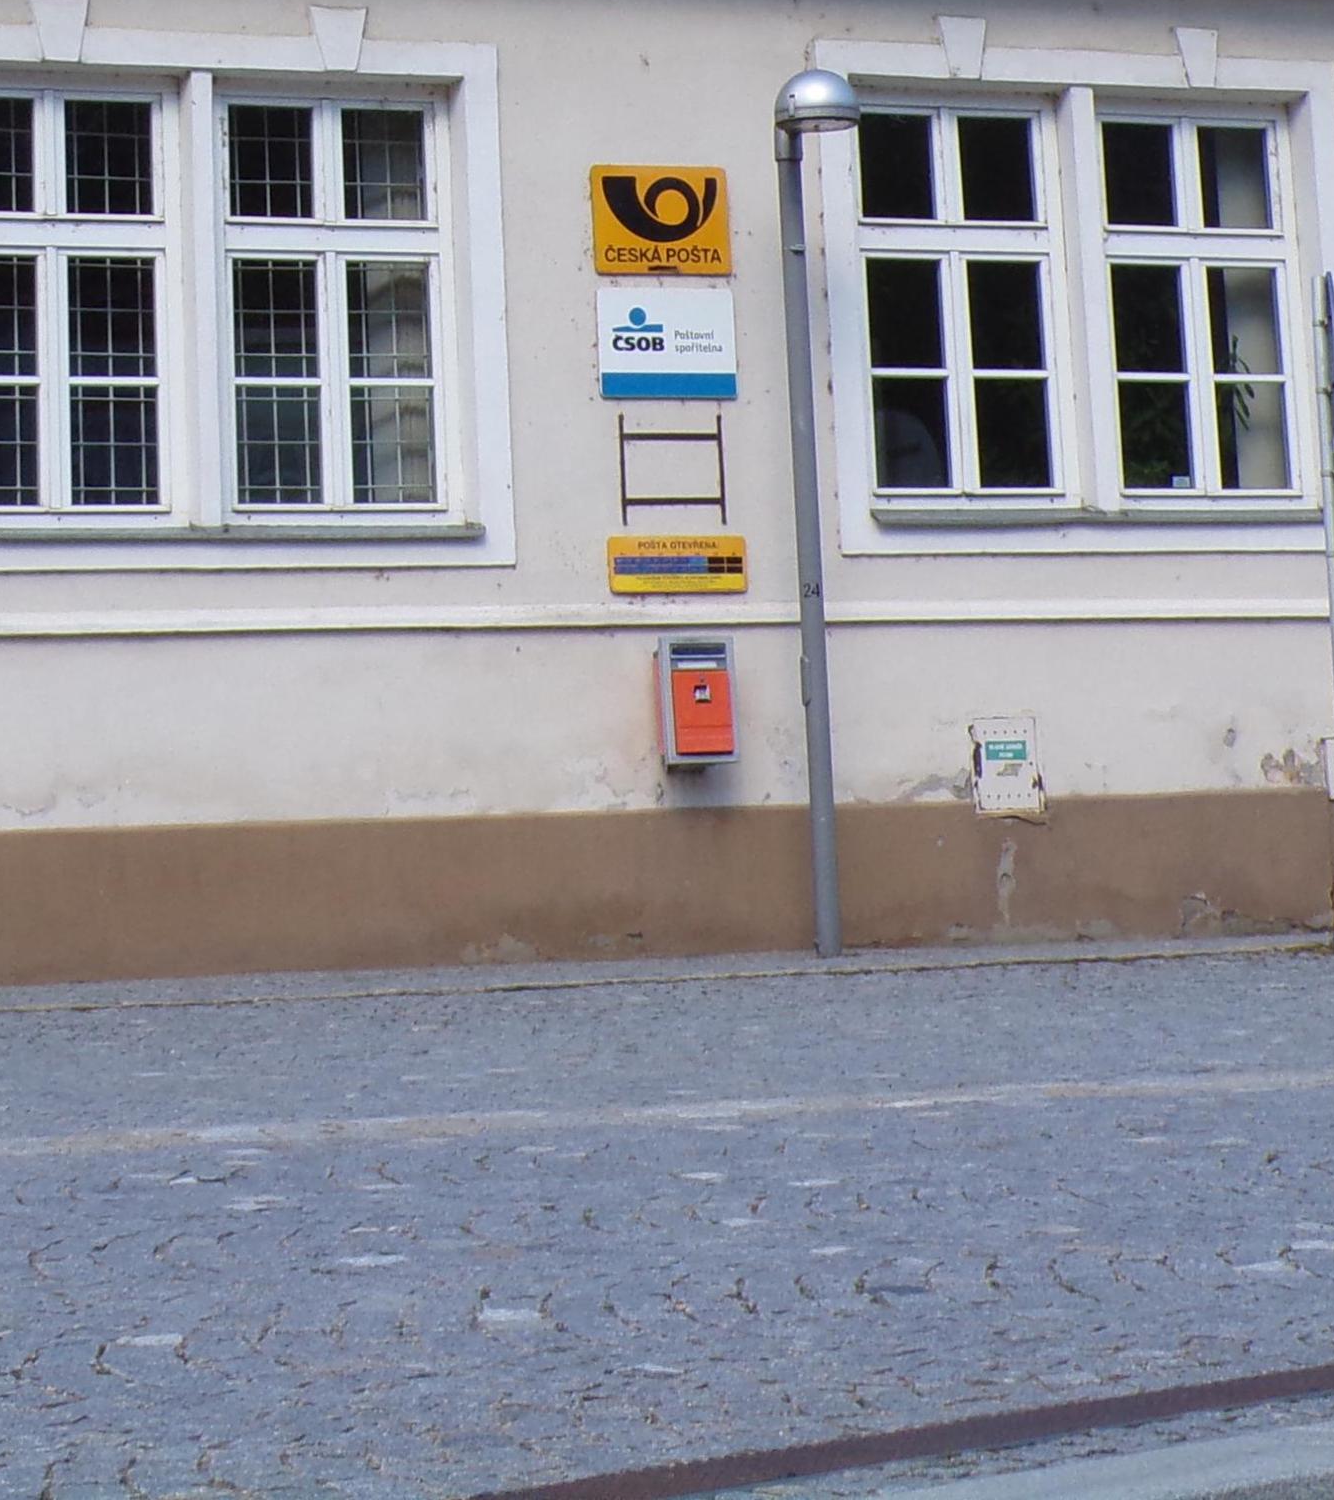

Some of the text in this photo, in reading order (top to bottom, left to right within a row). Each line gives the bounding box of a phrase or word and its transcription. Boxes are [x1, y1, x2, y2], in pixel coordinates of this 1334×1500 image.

[604, 244, 722, 263] ČESKÁ POŠTA
[674, 330, 714, 341] Poštovní
[612, 334, 665, 352] ČSOB
[674, 343, 723, 354] spořitelna
[637, 540, 667, 549] POŠTA
[803, 582, 820, 598] 24
